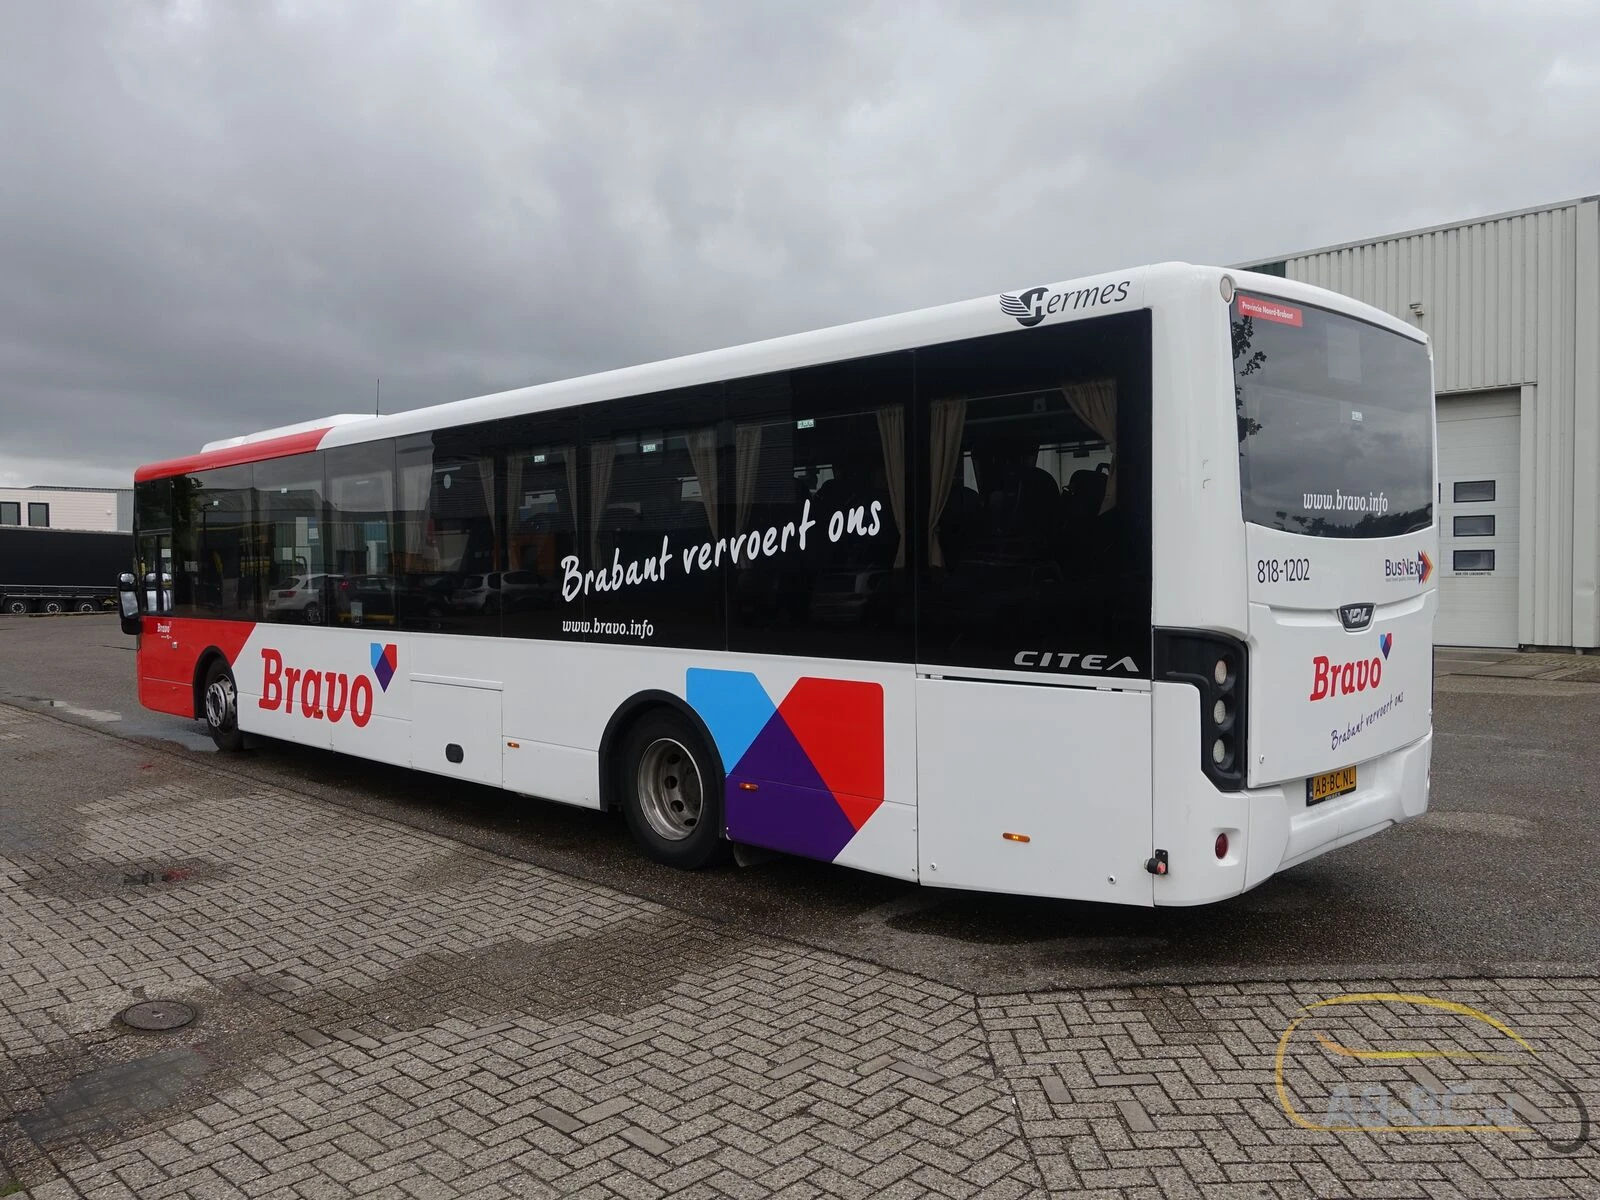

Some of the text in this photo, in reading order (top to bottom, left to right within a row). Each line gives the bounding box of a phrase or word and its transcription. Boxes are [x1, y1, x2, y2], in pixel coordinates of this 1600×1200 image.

[1016, 281, 1131, 326] Hermes
[1303, 489, 1388, 515] www.bravo.info
[561, 499, 882, 602] Brabant vervoert ons
[1257, 558, 1310, 583] 818-1202
[562, 618, 654, 639] www.bravo.info
[1345, 607, 1370, 624] VDL
[1014, 650, 1140, 672] CITEA
[1310, 655, 1382, 701] Bravo
[258, 647, 373, 728] Bravo
[1330, 715, 1364, 751] Brabant
[1365, 694, 1393, 726] vervoert
